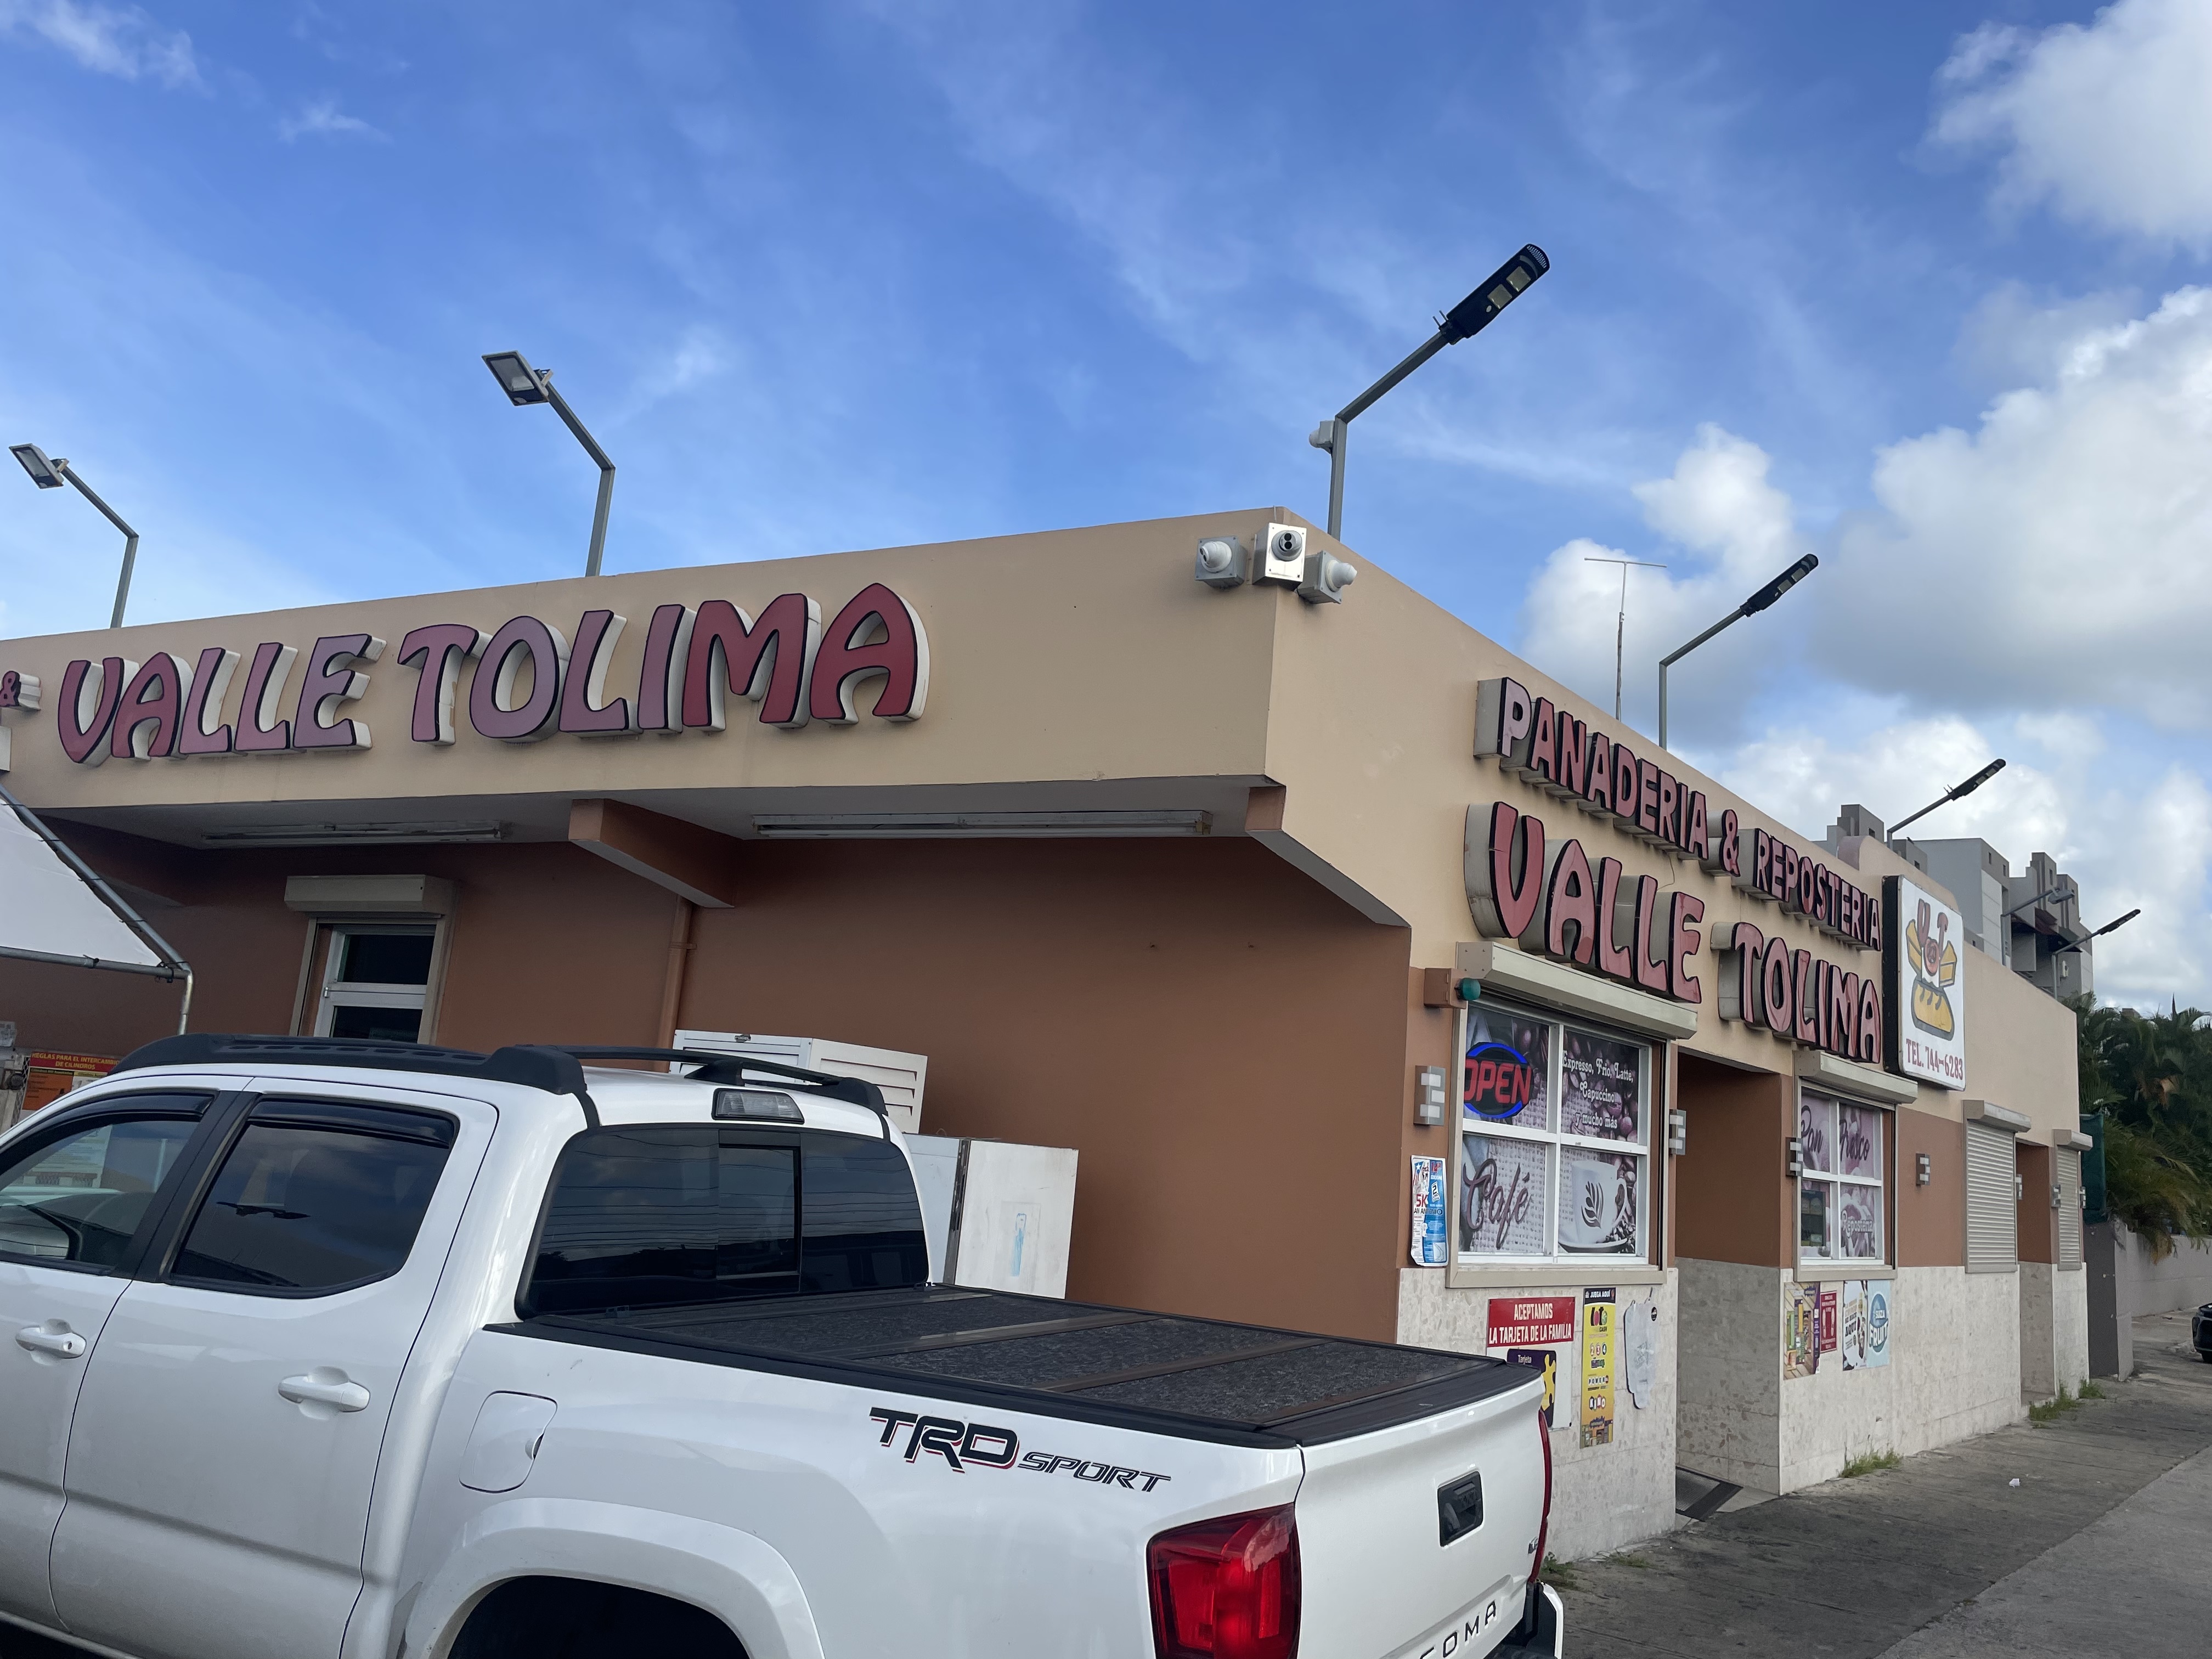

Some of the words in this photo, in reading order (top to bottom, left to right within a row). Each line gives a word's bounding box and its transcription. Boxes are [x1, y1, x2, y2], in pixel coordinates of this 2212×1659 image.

[58, 634, 373, 764] VALLE
[397, 583, 919, 743] TOLIMA
[1498, 676, 1709, 860] PANADERIA
[1720, 809, 1741, 877] &
[1753, 828, 1882, 951] REPOSTERIA
[1490, 801, 1705, 1003] VALLE
[1731, 922, 1881, 1063] TOLIMA
[65, 1062, 95, 1070] CILINDROS
[81, 1057, 120, 1065] INTERCAMBIO
[1562, 1050, 1594, 1075] Expresso,
[1596, 1058, 1612, 1079] Frio,
[1615, 1062, 1634, 1083] Latte,
[1906, 1038, 1924, 1068] TEL.
[1925, 1046, 1963, 1080] 744-6283
[1464, 1058, 1531, 1104] OPEN
[1579, 1080, 1615, 1103] Capuccino
[1575, 1113, 1582, 1126] y
[1582, 1114, 1603, 1127] mucho
[1605, 1115, 1618, 1128] más
[1417, 1194, 1428, 1207] 5K
[1432, 1184, 1437, 1195] 2
[1463, 1158, 1532, 1250] Café
[1514, 1303, 1553, 1321] ACEPTAMOS
[1489, 1327, 1498, 1344] LA
[1499, 1325, 1529, 1344] TARJETA
[1530, 1325, 1539, 1342] DE
[1540, 1324, 1548, 1341] LA
[1548, 1323, 1572, 1340] FAMILIA
[1517, 1355, 1532, 1365] Tarjeta
[870, 1407, 1019, 1474] TRD
[1018, 1452, 1171, 1492] SPORT
